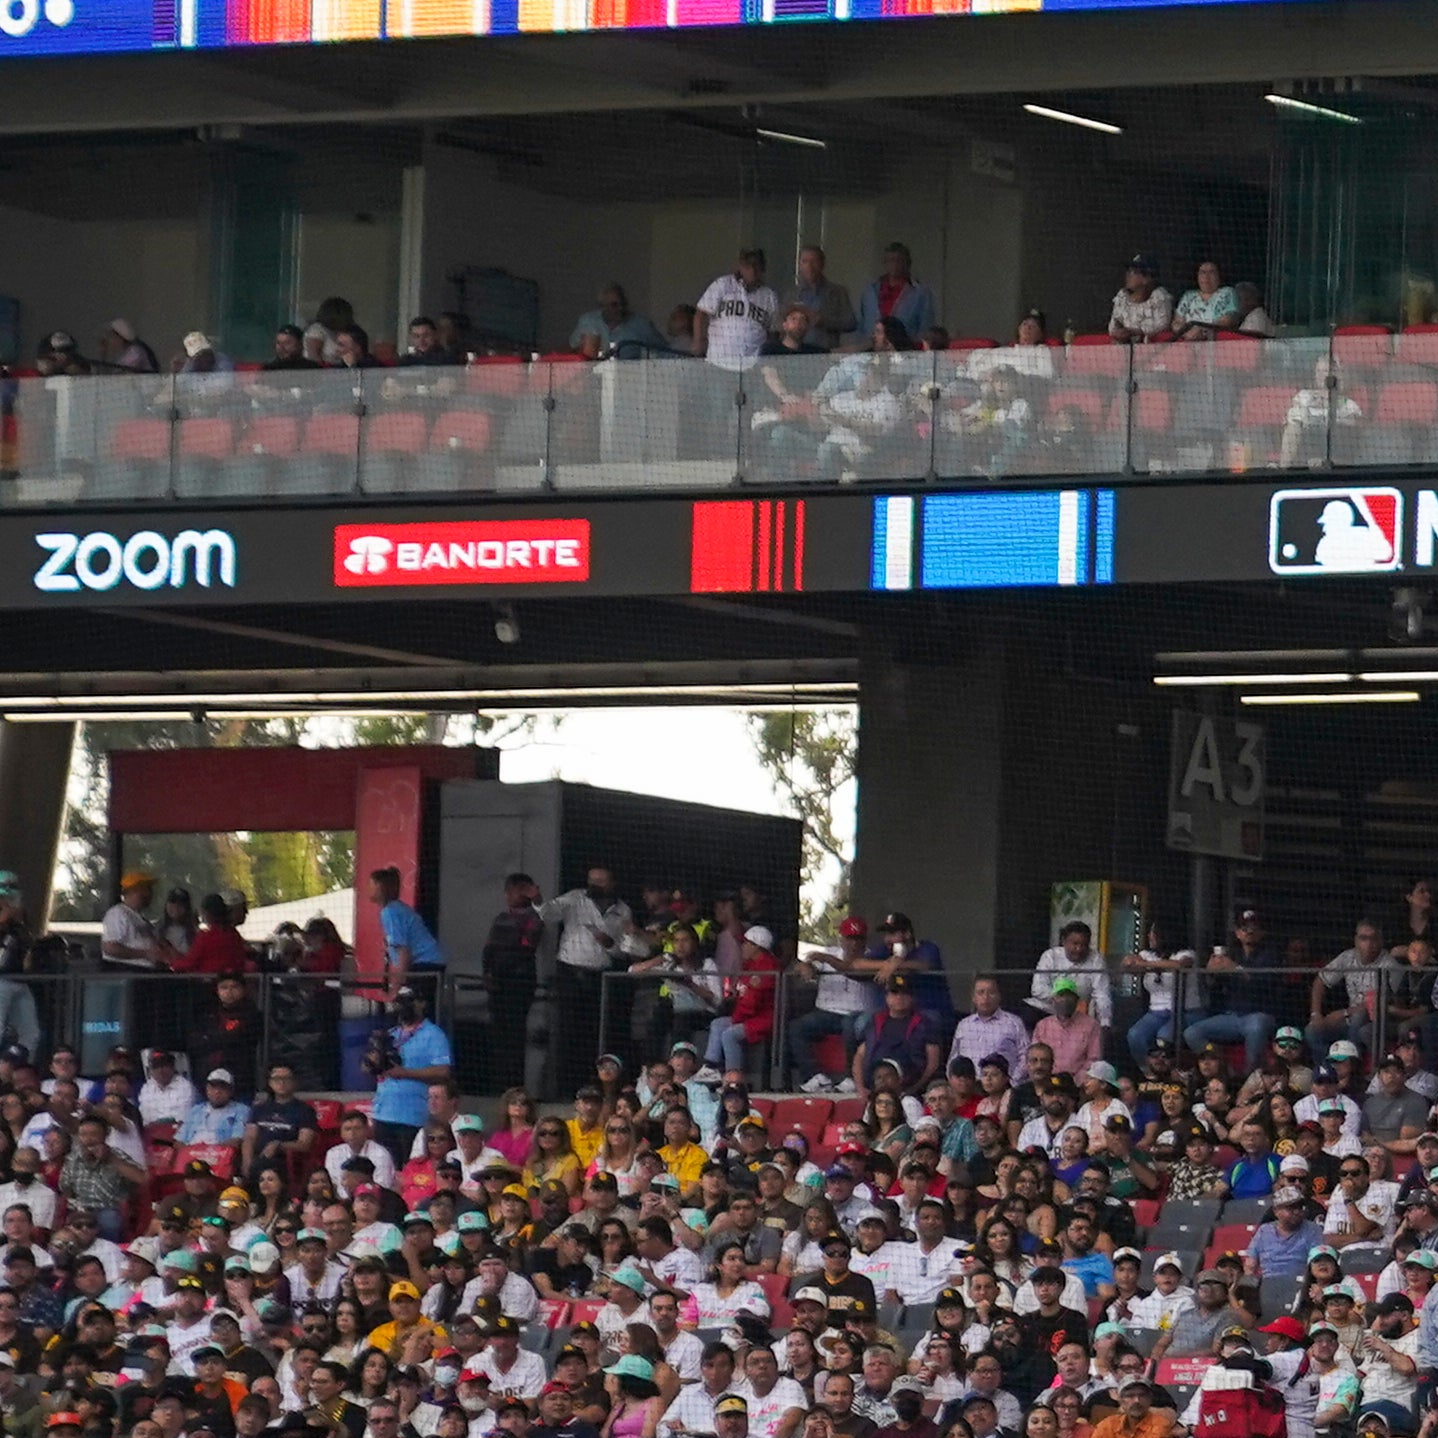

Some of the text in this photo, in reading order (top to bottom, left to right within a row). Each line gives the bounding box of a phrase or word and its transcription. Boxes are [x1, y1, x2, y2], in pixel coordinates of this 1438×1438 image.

[34, 529, 236, 589] zoom
[397, 539, 580, 570] BANORTE
[1181, 716, 1263, 806] A3
